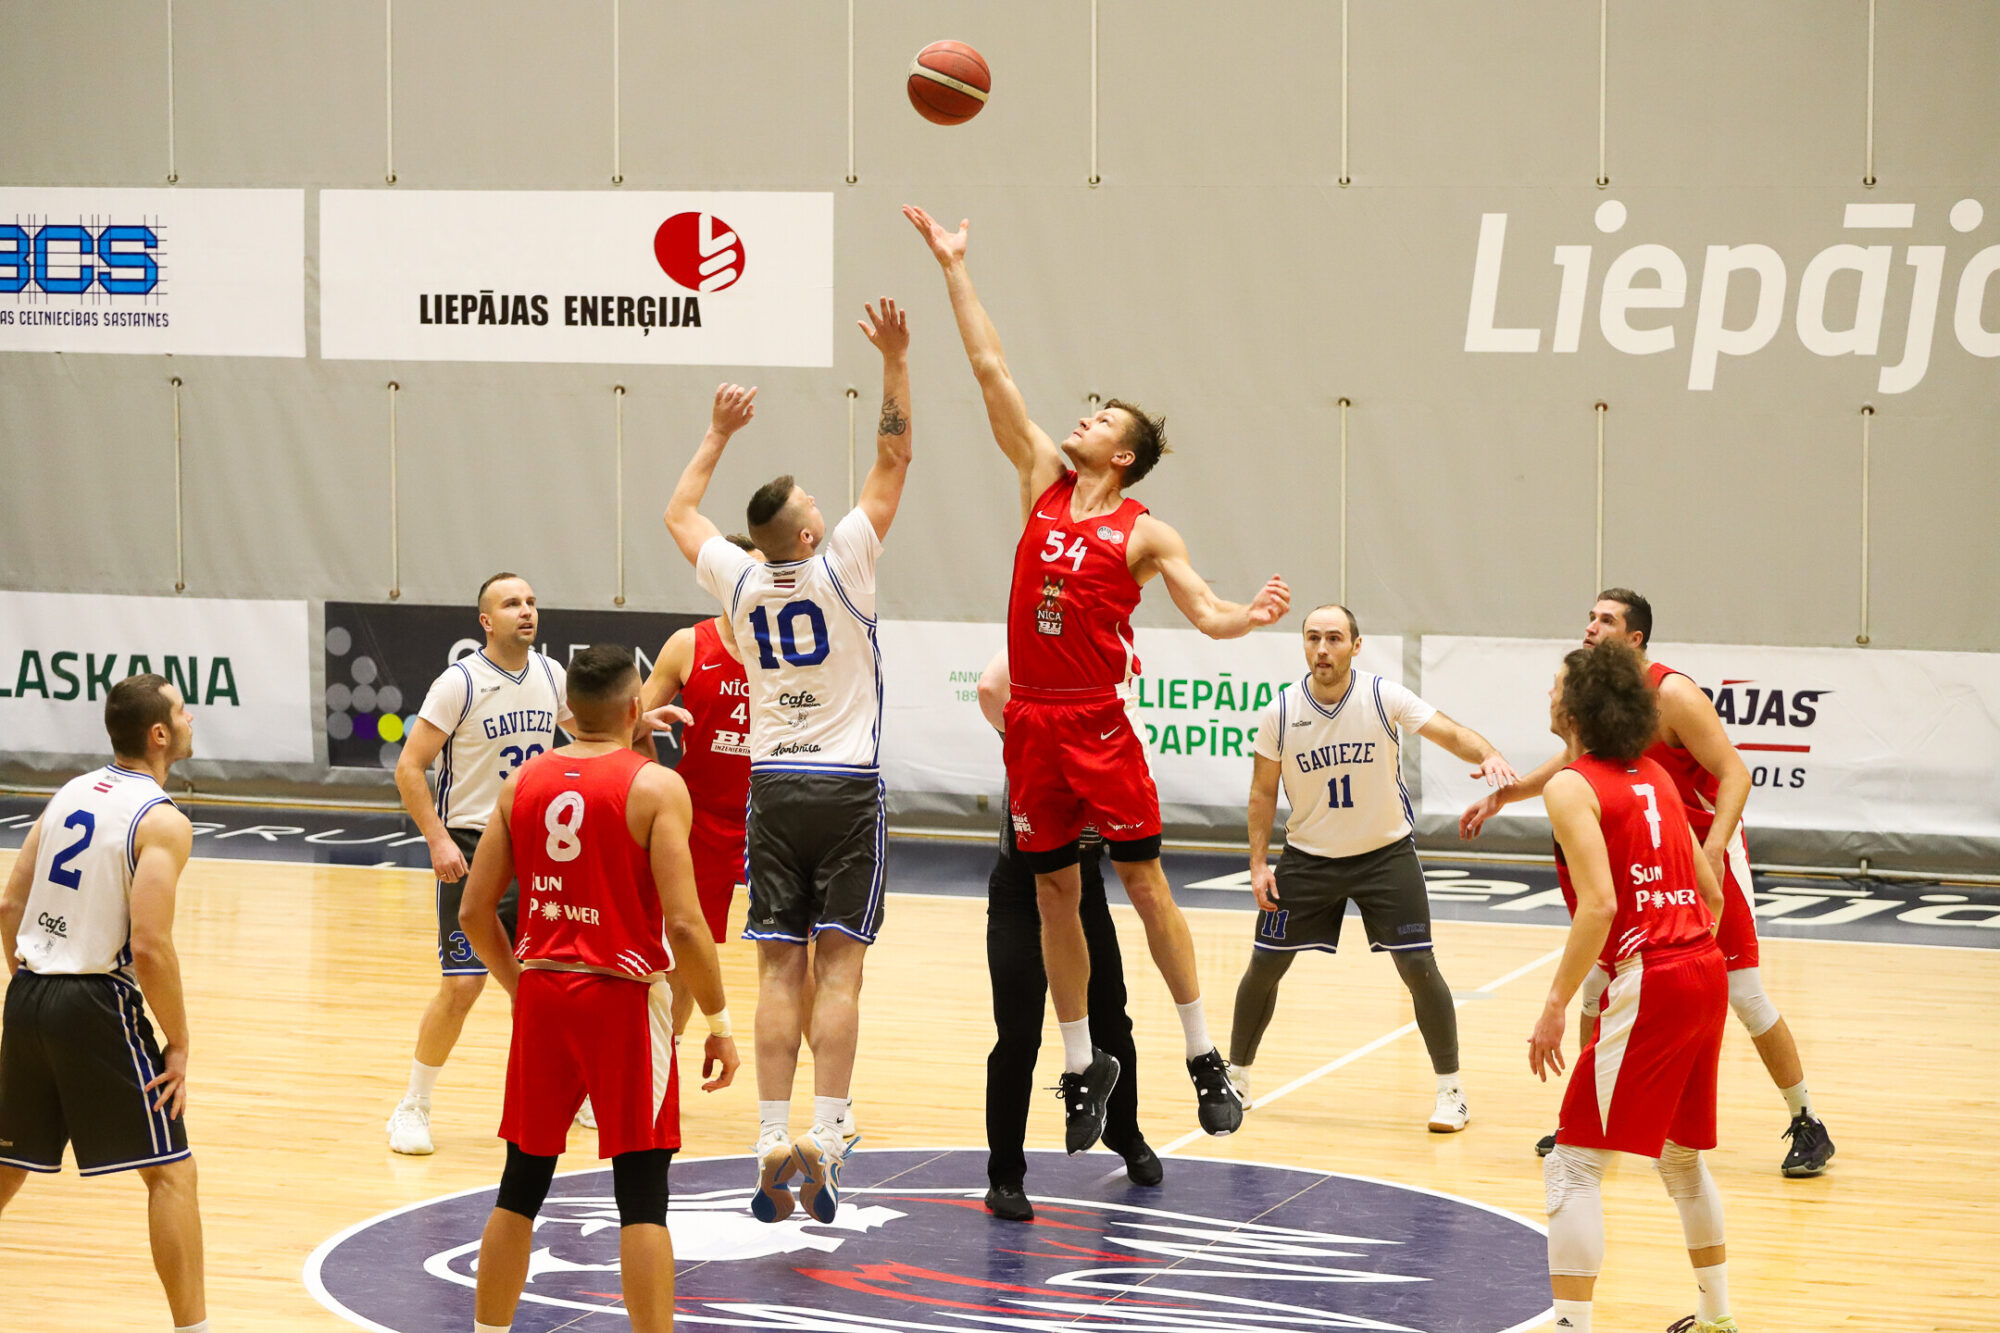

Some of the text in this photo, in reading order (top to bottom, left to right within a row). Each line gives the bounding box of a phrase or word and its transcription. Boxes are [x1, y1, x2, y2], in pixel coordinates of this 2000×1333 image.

[19, 309, 99, 327] CELTNIECĪBAS
[103, 312, 169, 328] SASTATNES
[419, 290, 702, 336] LIEPĀJAS ENERĢIJA
[1040, 530, 1089, 572] 54
[748, 598, 831, 669] 10
[730, 702, 748, 725] 4
[779, 690, 816, 708] Cafe
[483, 709, 553, 740] GAVIEZE
[1296, 742, 1376, 774] GAVIEZE
[1328, 774, 1354, 808] 11
[544, 790, 585, 862] 8
[1630, 783, 1662, 850] 7
[48, 809, 95, 891] 2
[531, 872, 563, 892] UN
[38, 911, 66, 933] Cafe
[448, 930, 481, 962] 3
